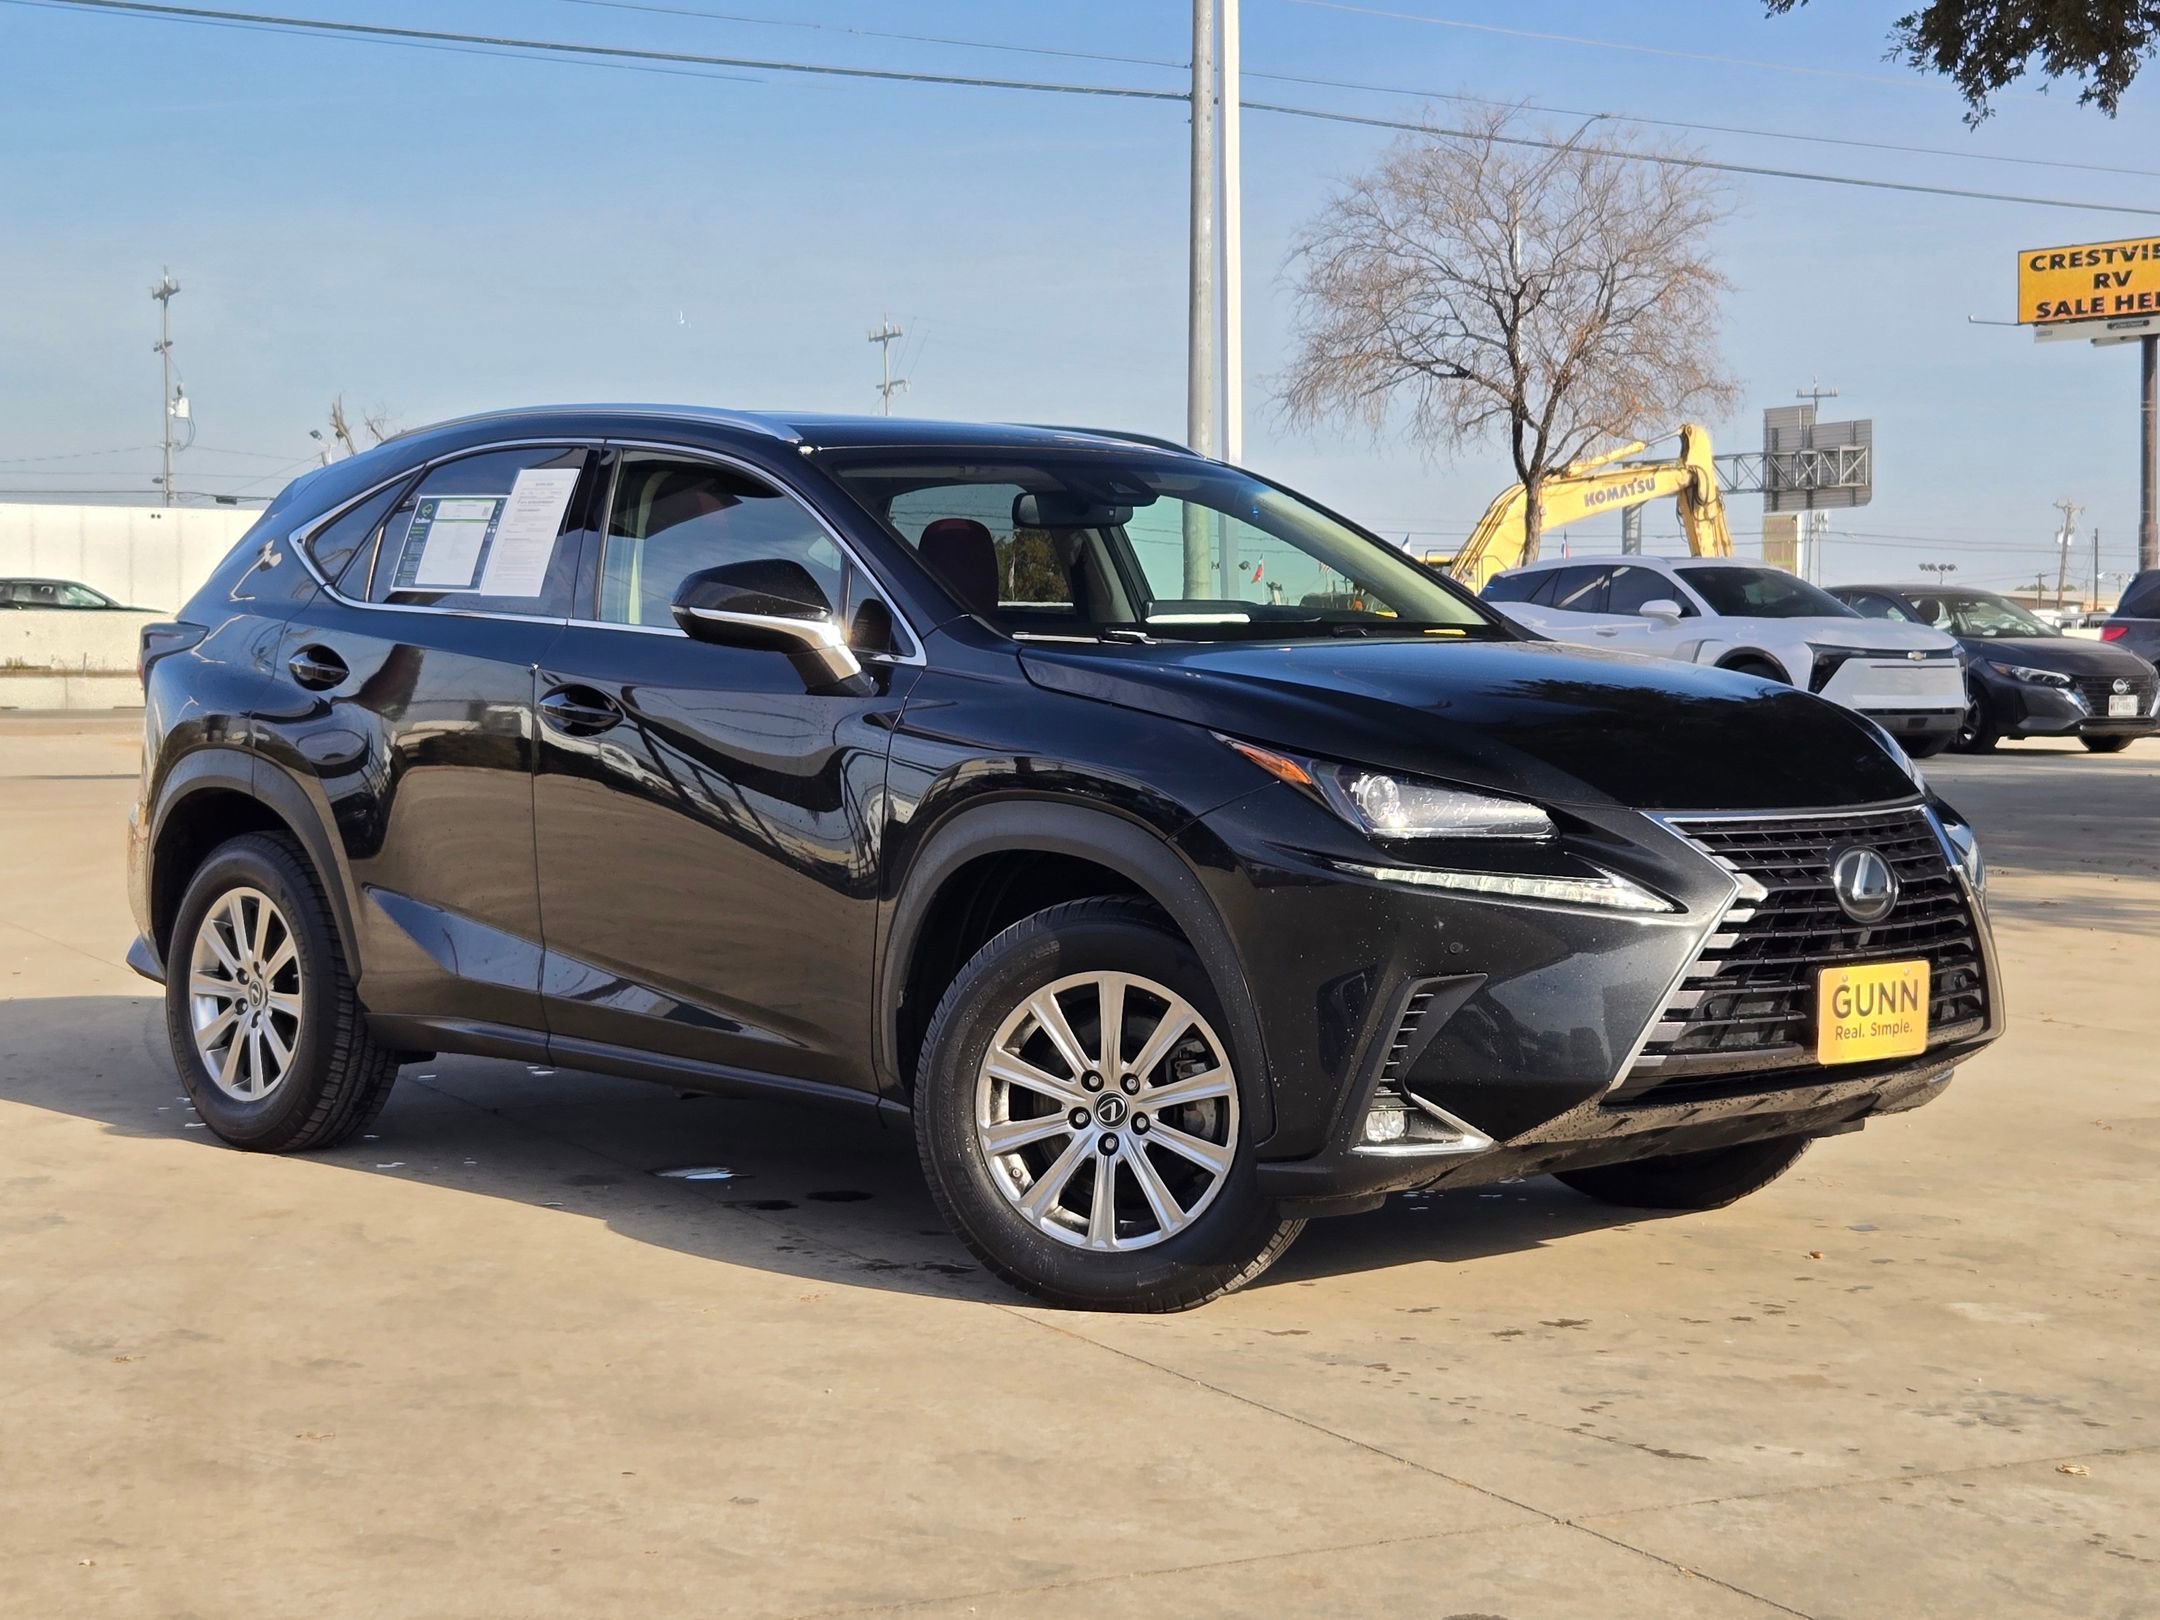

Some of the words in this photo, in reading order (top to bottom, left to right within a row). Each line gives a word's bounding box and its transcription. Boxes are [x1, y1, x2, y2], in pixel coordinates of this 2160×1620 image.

[2093, 270, 2133, 289] RV
[2036, 296, 2104, 319] SALE
[1584, 477, 1655, 507] KOMATSU
[1832, 979, 1918, 1019] GUNN
[1835, 1023, 1865, 1040] Real.
[1871, 1019, 1913, 1039] Simple.
